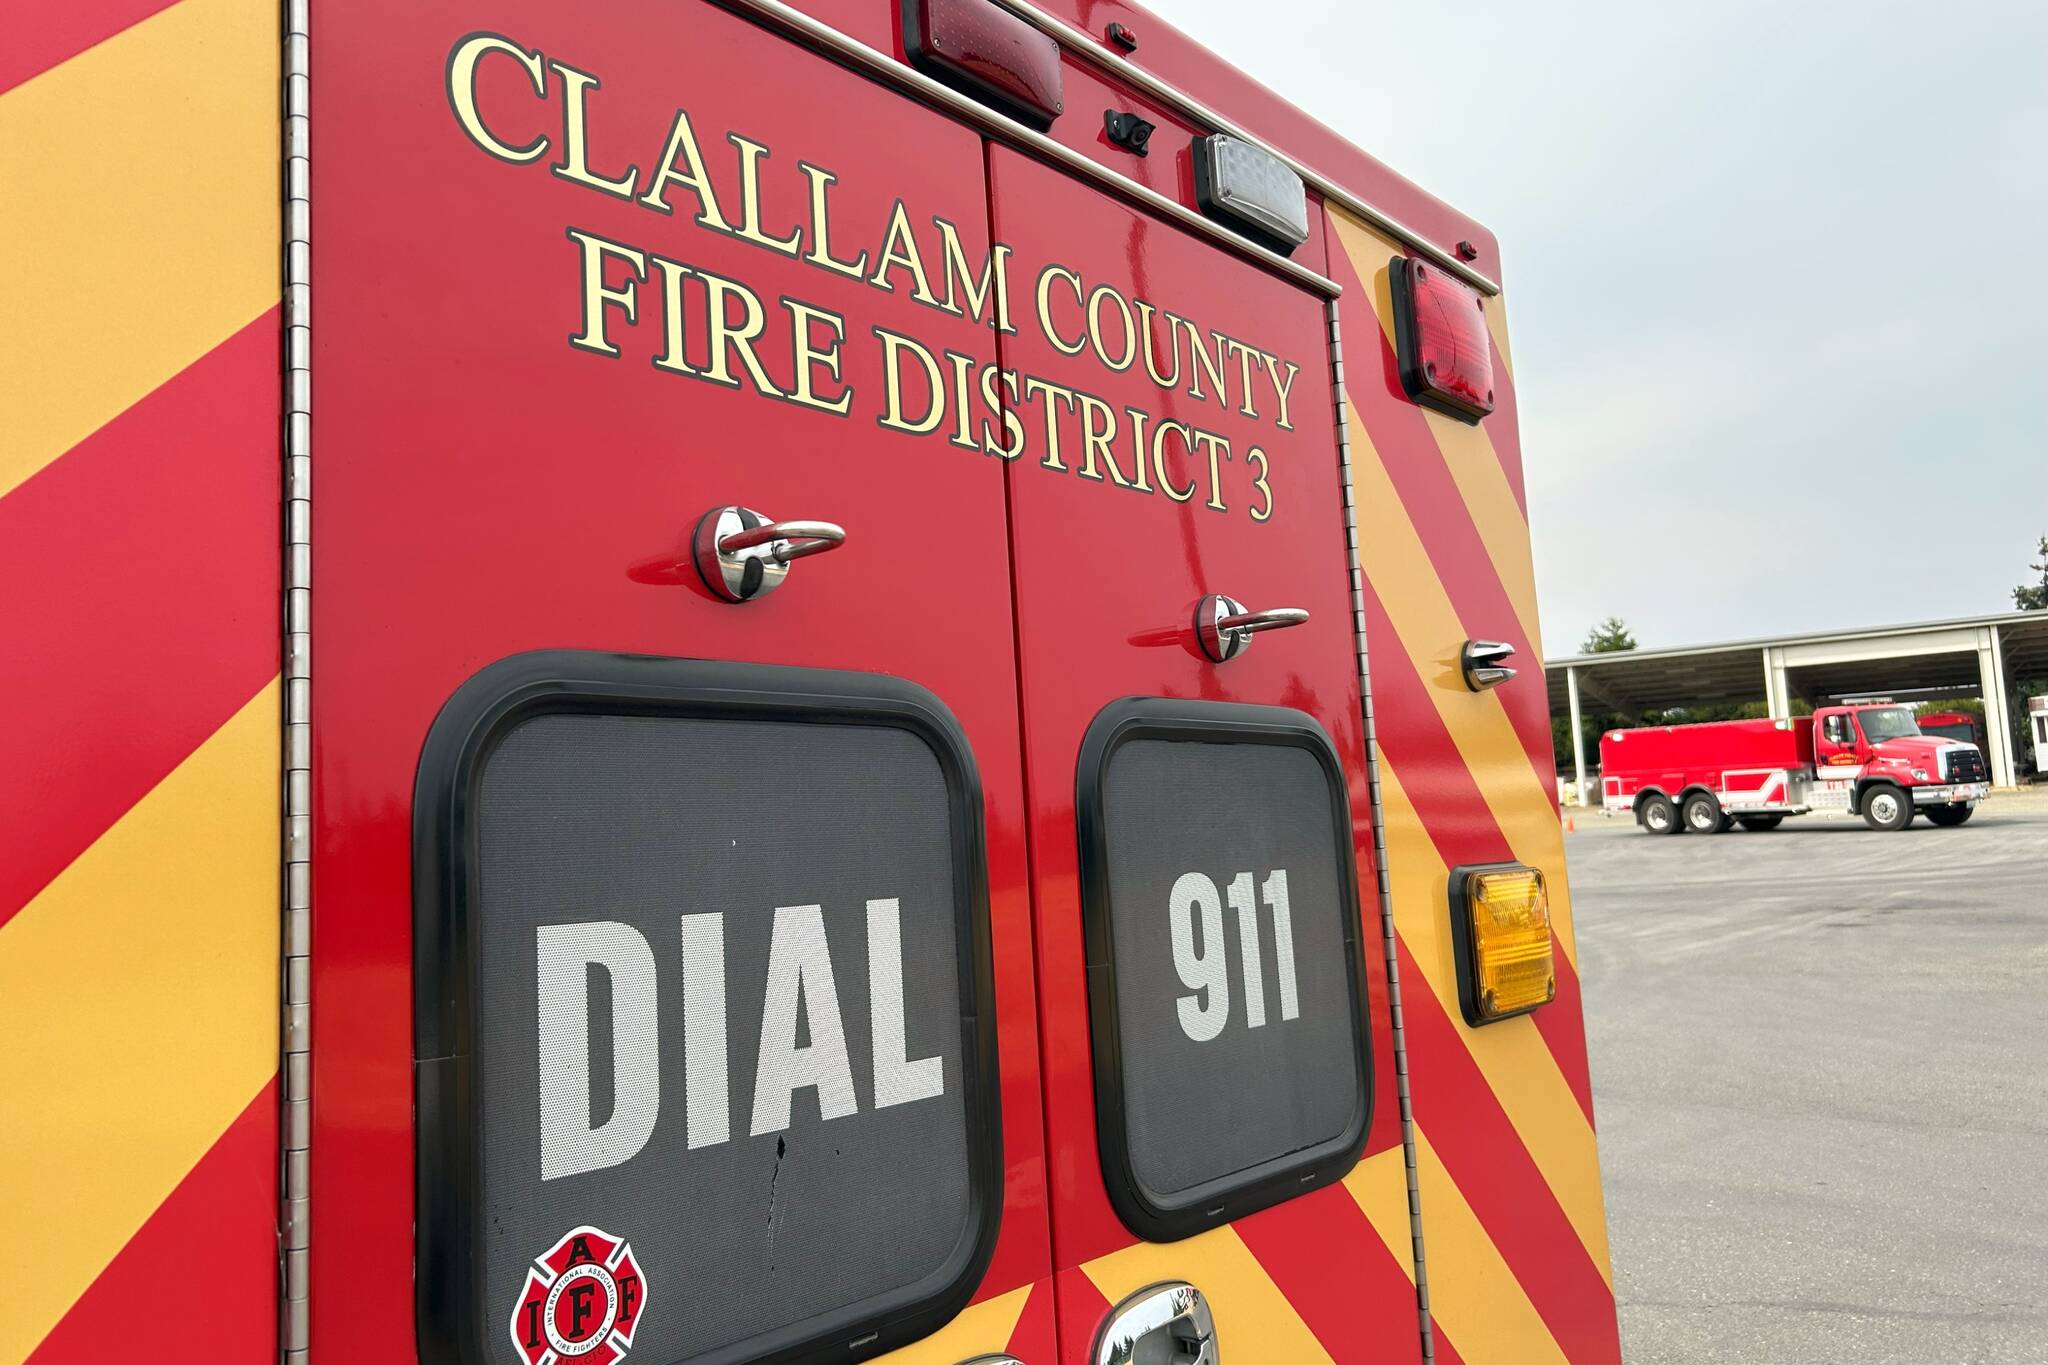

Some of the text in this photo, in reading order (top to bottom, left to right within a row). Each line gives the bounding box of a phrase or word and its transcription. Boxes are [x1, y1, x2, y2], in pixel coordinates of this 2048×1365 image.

[446, 31, 1299, 431] CLALLAM COUNTY
[566, 226, 1274, 522] FIRE DISTRICT 3
[536, 869, 1300, 1181] DIAL 911
[547, 1267, 615, 1326] INTERNATIONAL ASSOCIATION
[555, 1326, 608, 1353] FIRE FIGHTERS
